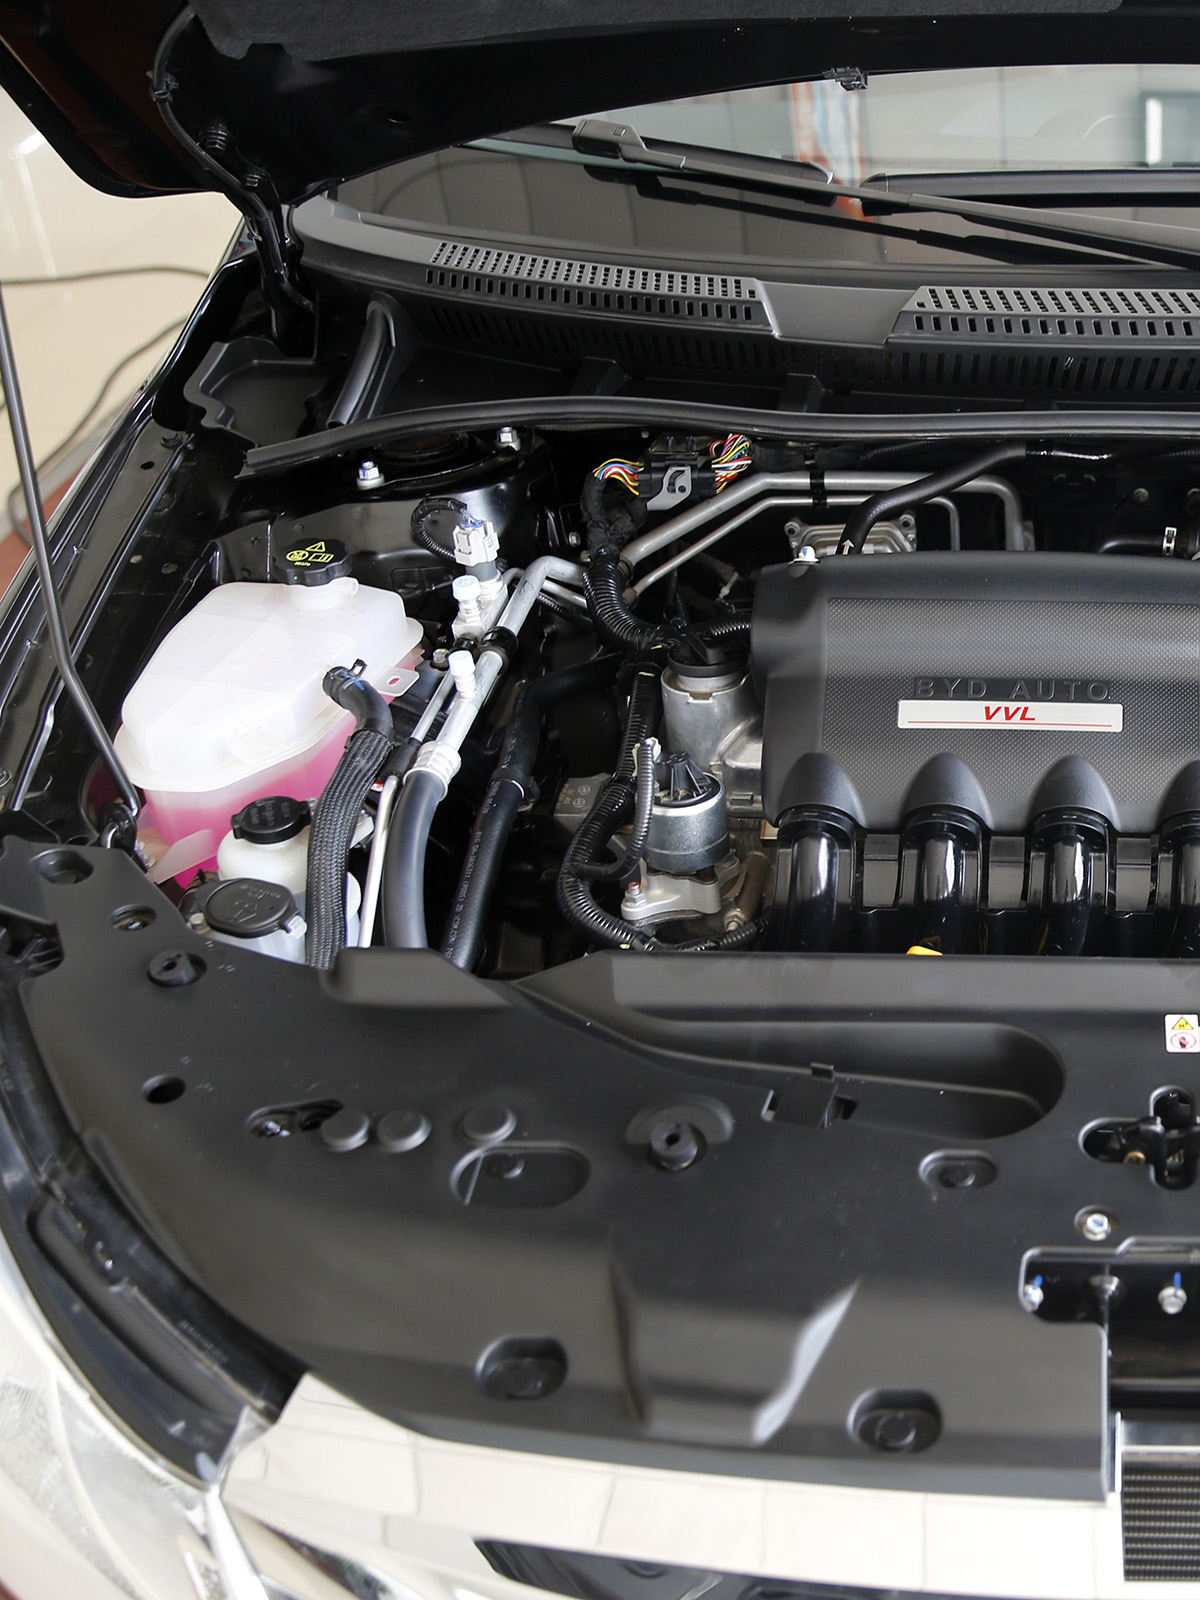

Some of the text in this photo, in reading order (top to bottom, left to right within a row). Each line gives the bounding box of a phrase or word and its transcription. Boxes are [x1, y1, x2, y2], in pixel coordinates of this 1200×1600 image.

[917, 677, 1109, 701] BYD AUTO
[984, 705, 1036, 721] VVL
